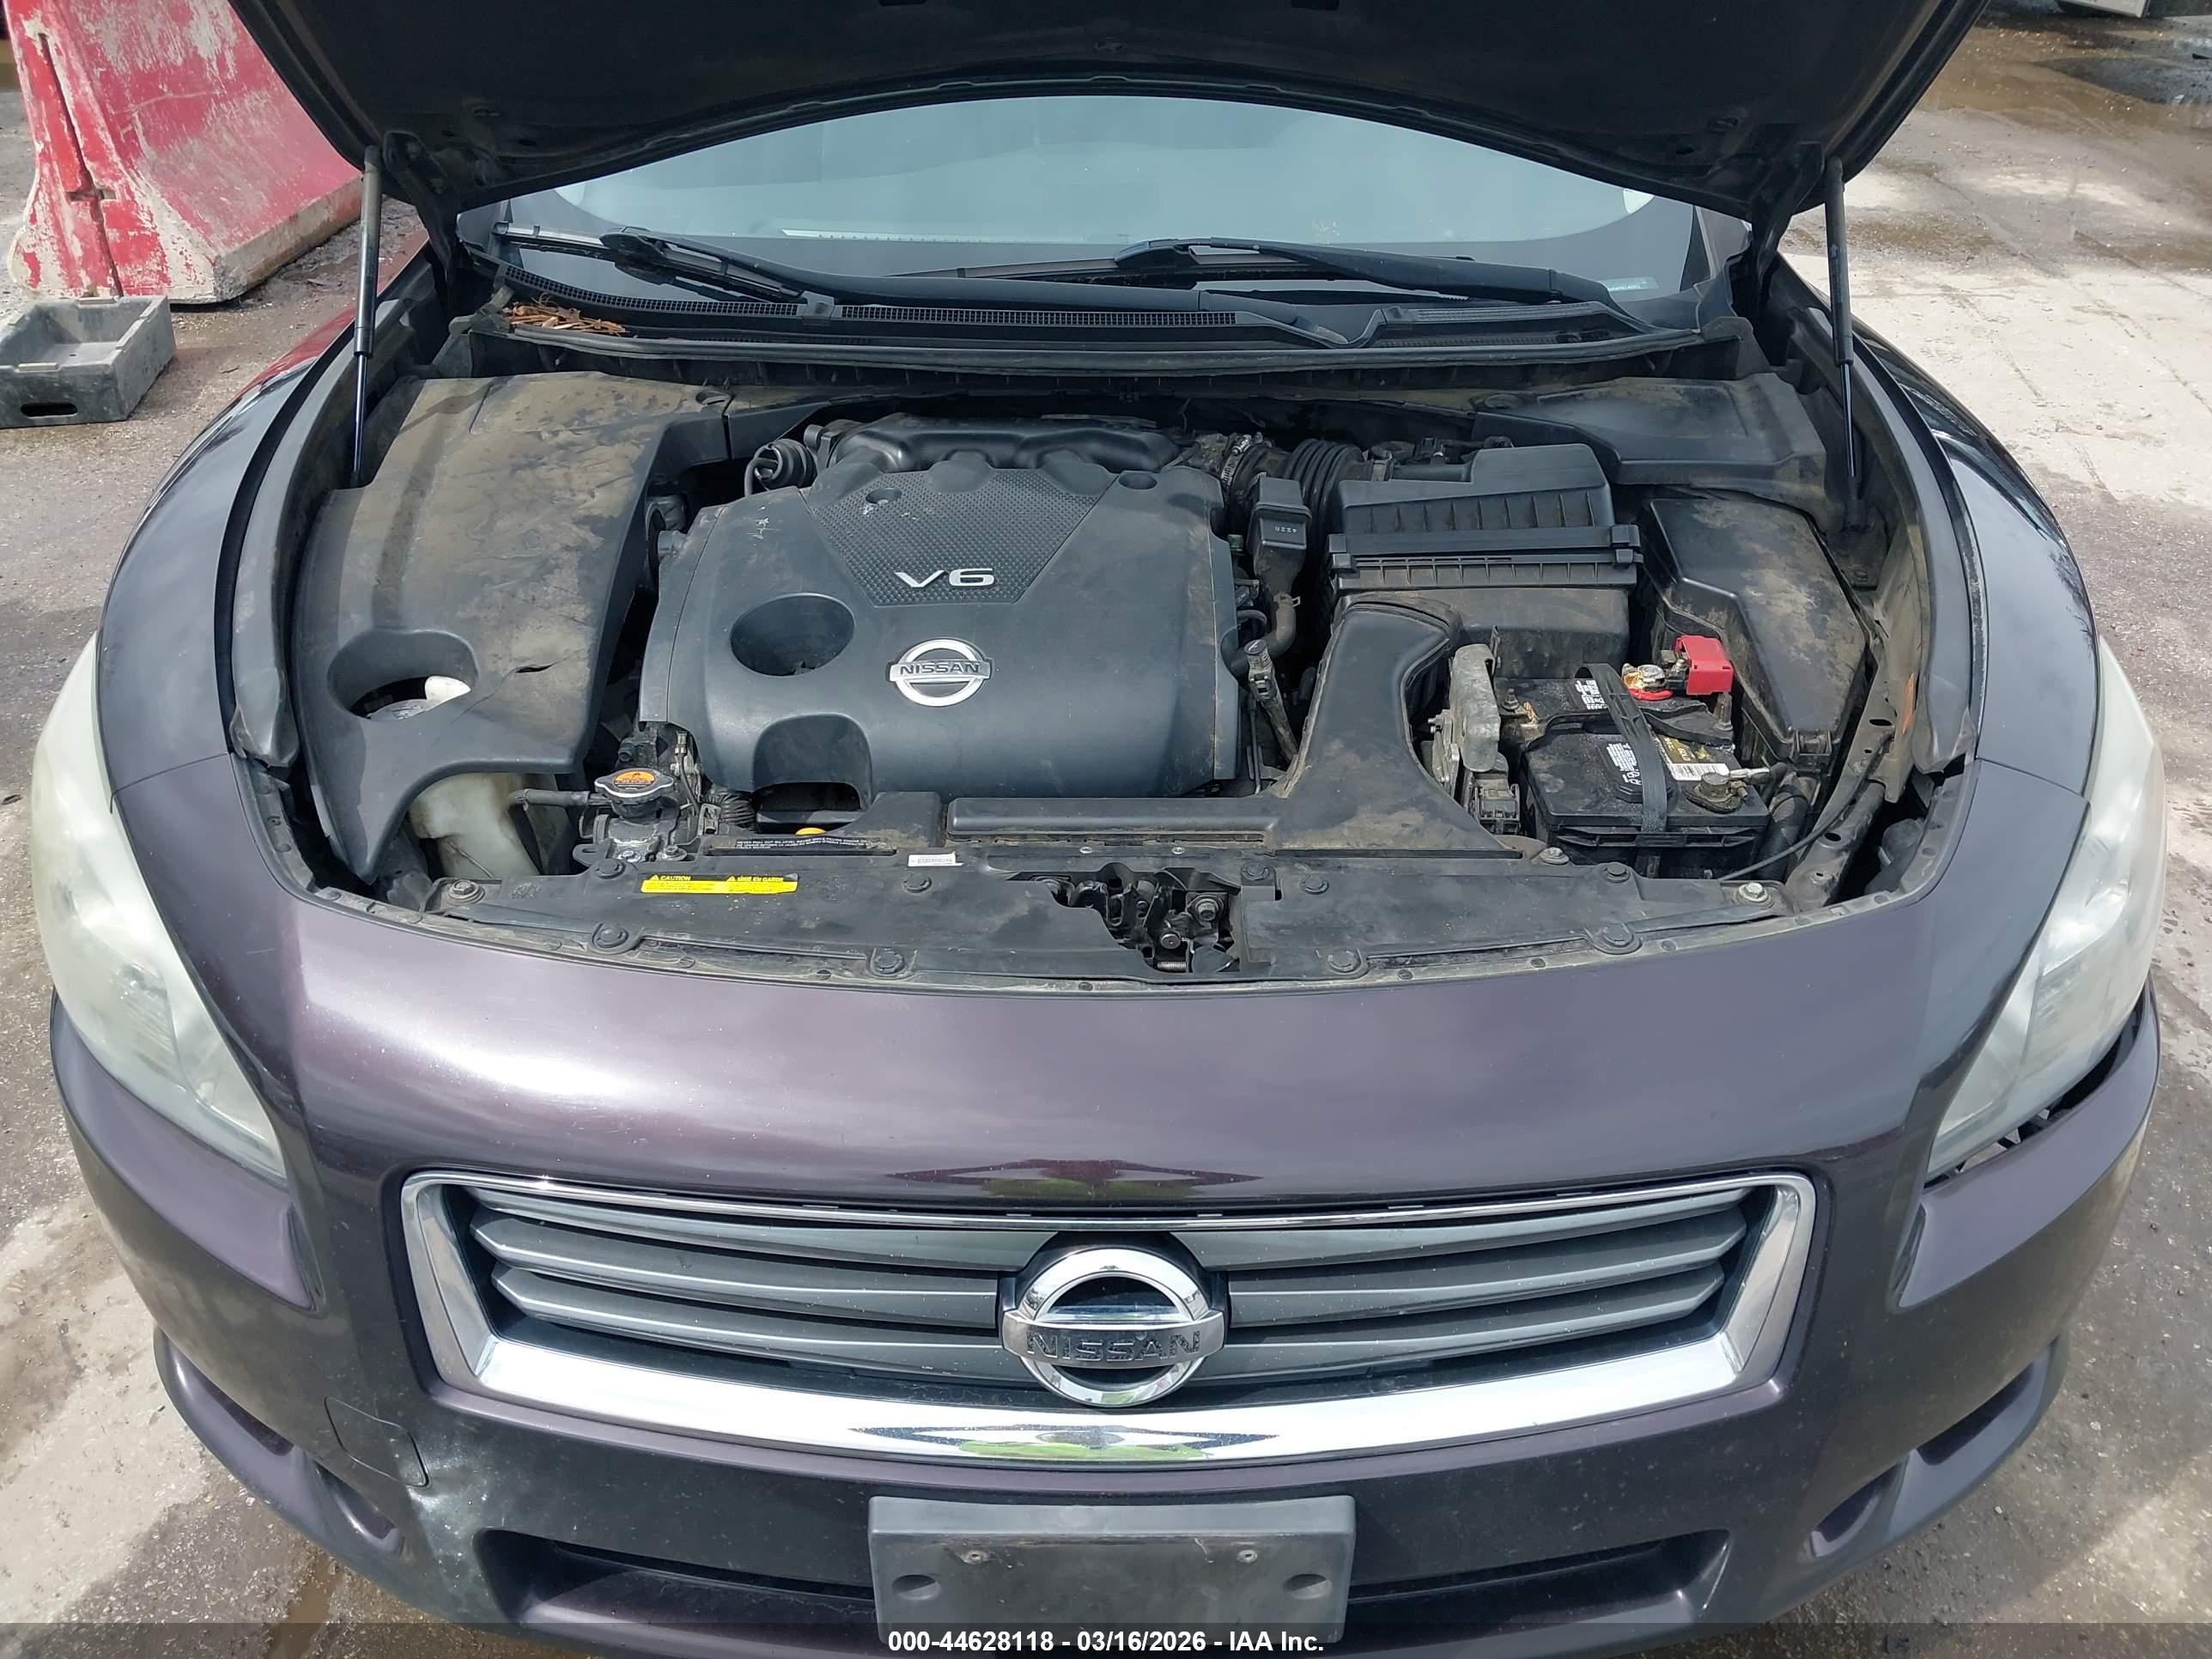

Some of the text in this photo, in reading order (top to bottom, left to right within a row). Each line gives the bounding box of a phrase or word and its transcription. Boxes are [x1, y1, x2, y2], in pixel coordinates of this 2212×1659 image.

[894, 568, 995, 588] V6
[899, 662, 981, 676] NISSAN
[1026, 1330, 1201, 1362] NISSAN
